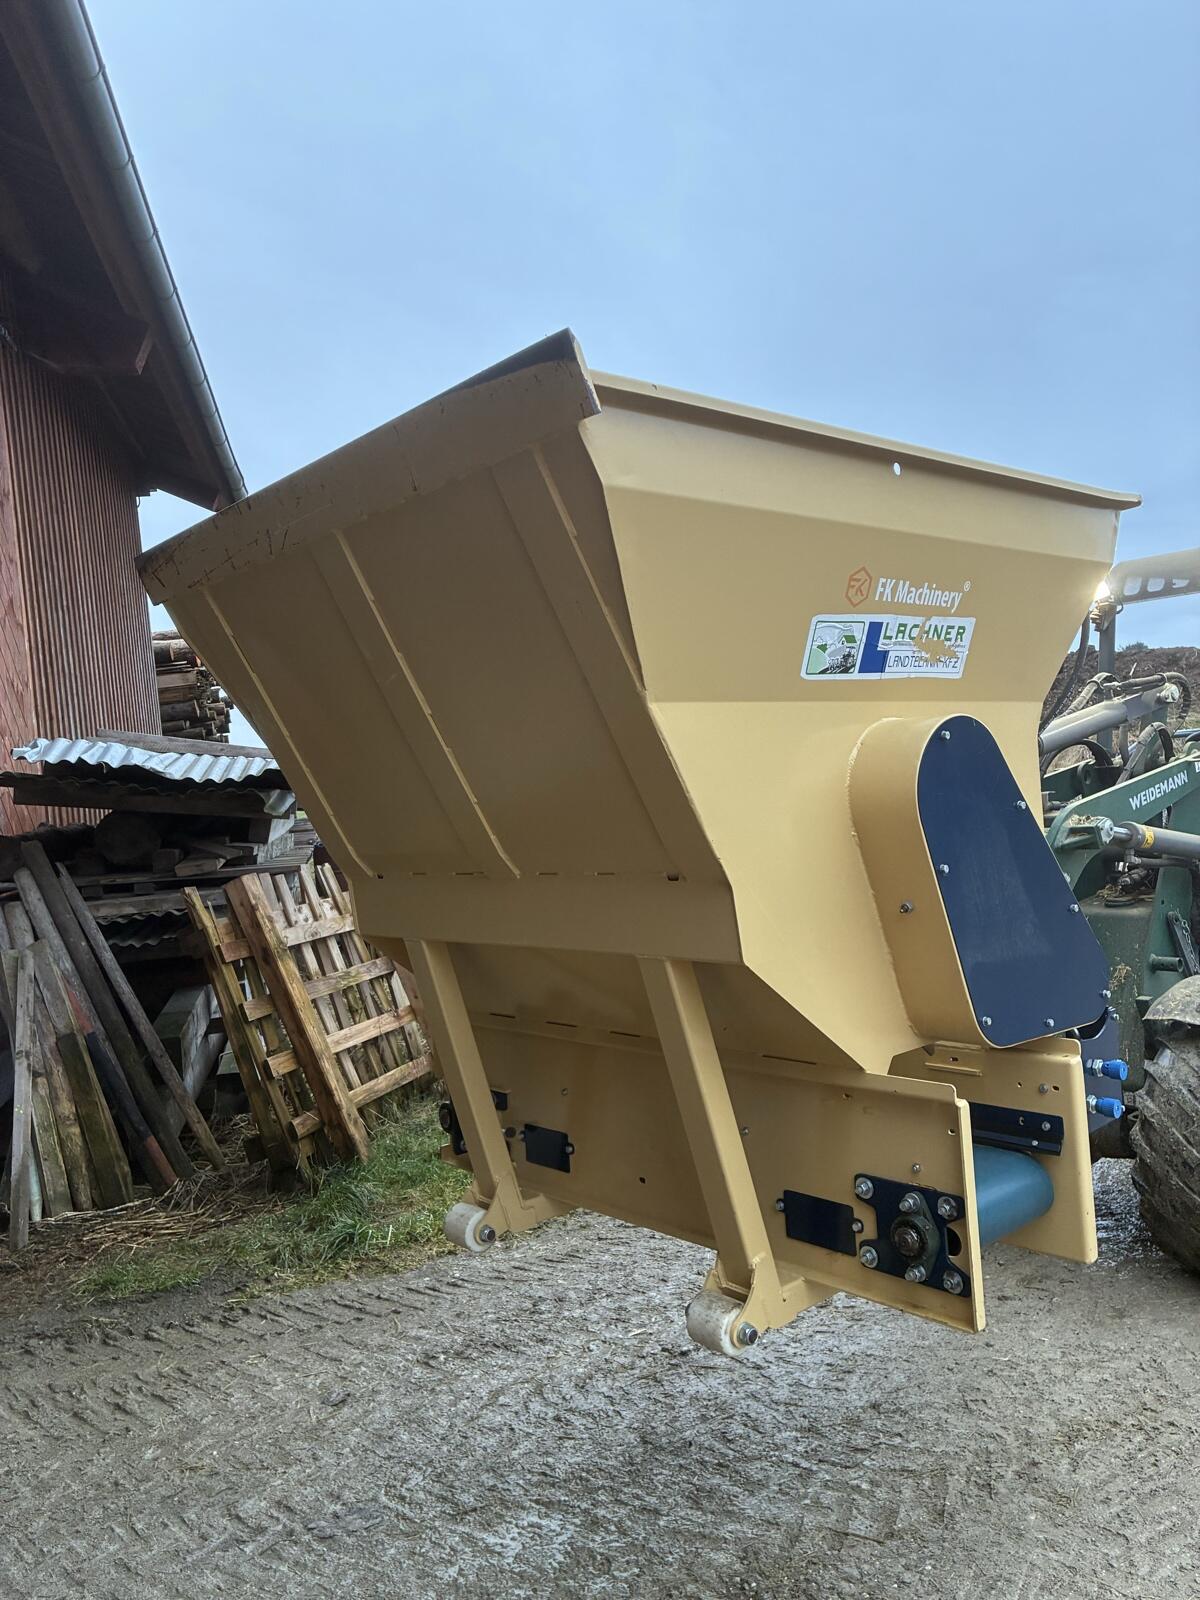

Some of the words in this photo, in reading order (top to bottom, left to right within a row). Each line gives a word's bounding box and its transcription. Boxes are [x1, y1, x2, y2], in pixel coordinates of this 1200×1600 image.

[875, 577, 896, 602] FK
[882, 622, 966, 642] LACHNER
[1129, 770, 1189, 811] WEIDEMANN
